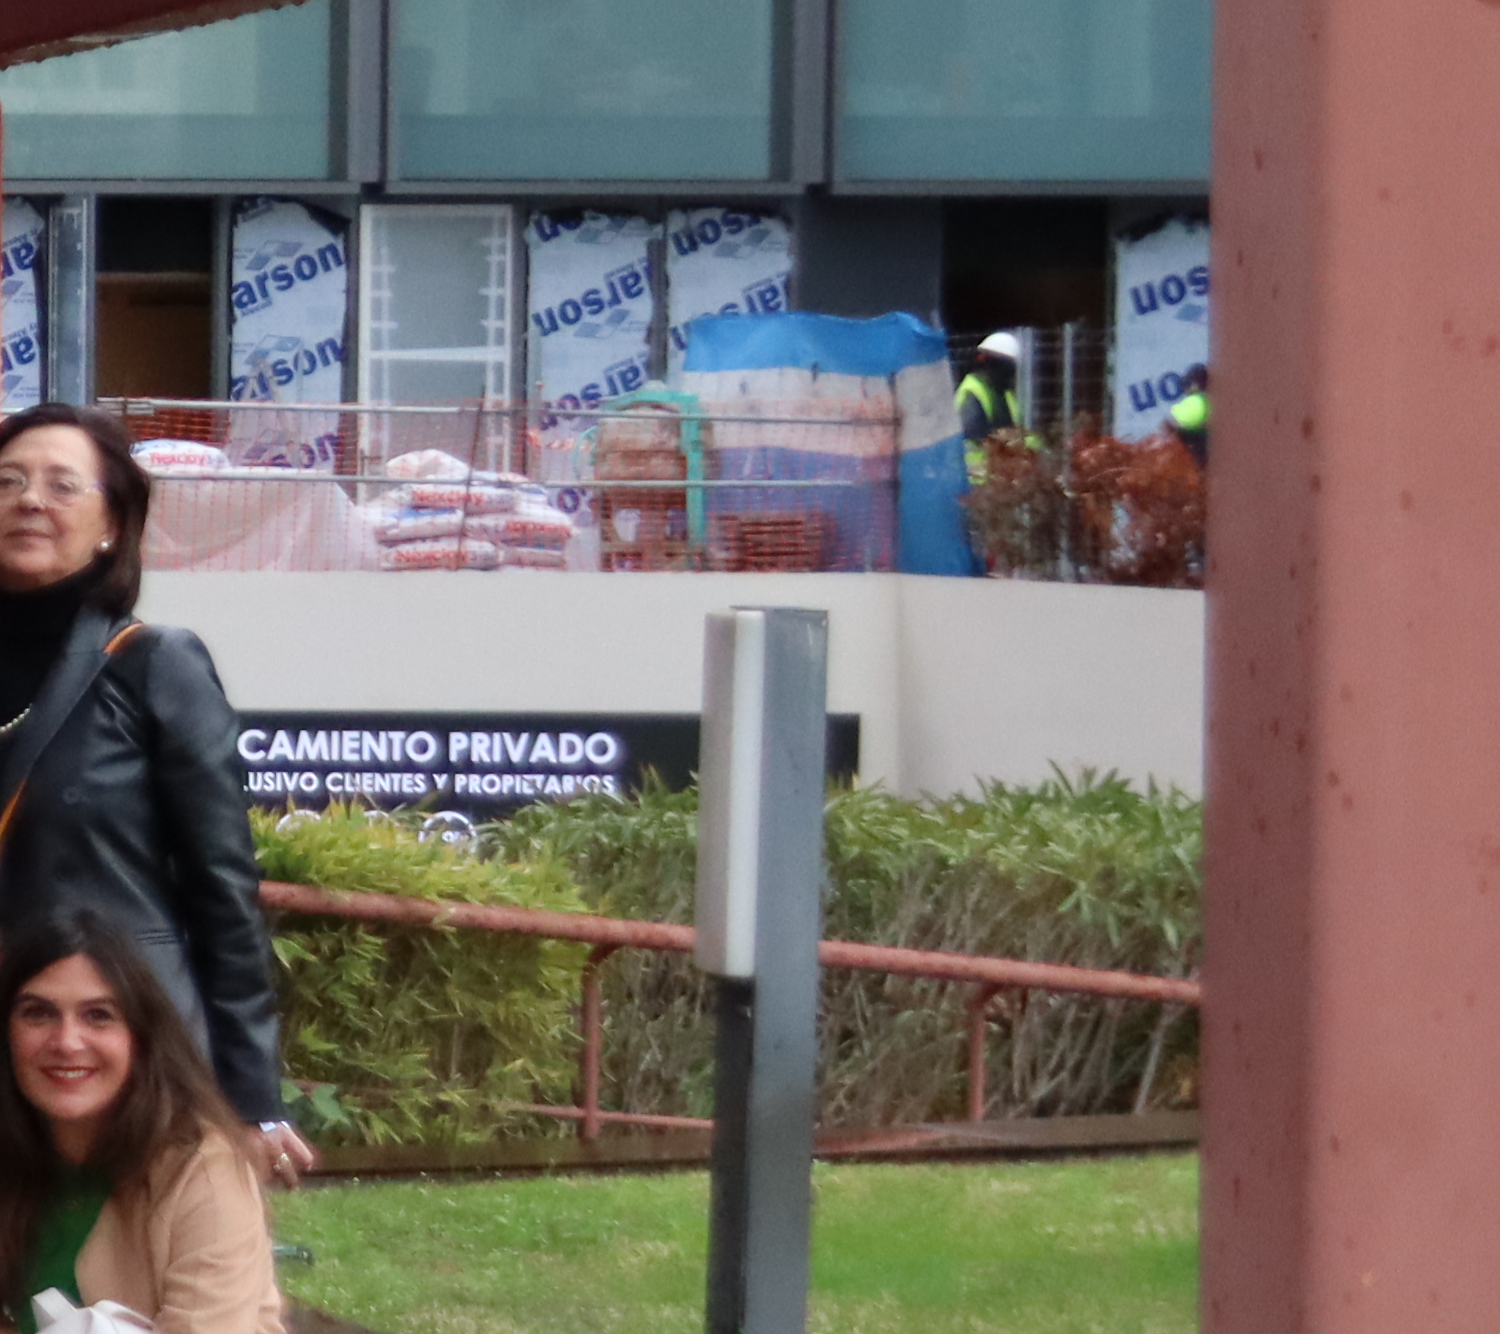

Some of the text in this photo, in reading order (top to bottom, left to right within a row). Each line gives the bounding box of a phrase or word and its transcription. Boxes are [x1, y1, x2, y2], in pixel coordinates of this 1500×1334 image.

[532, 257, 652, 337] arson
[237, 728, 618, 766] CAMIENTO PRIVADO
[325, 771, 428, 795] CLIENTES
[432, 773, 450, 791] Y
